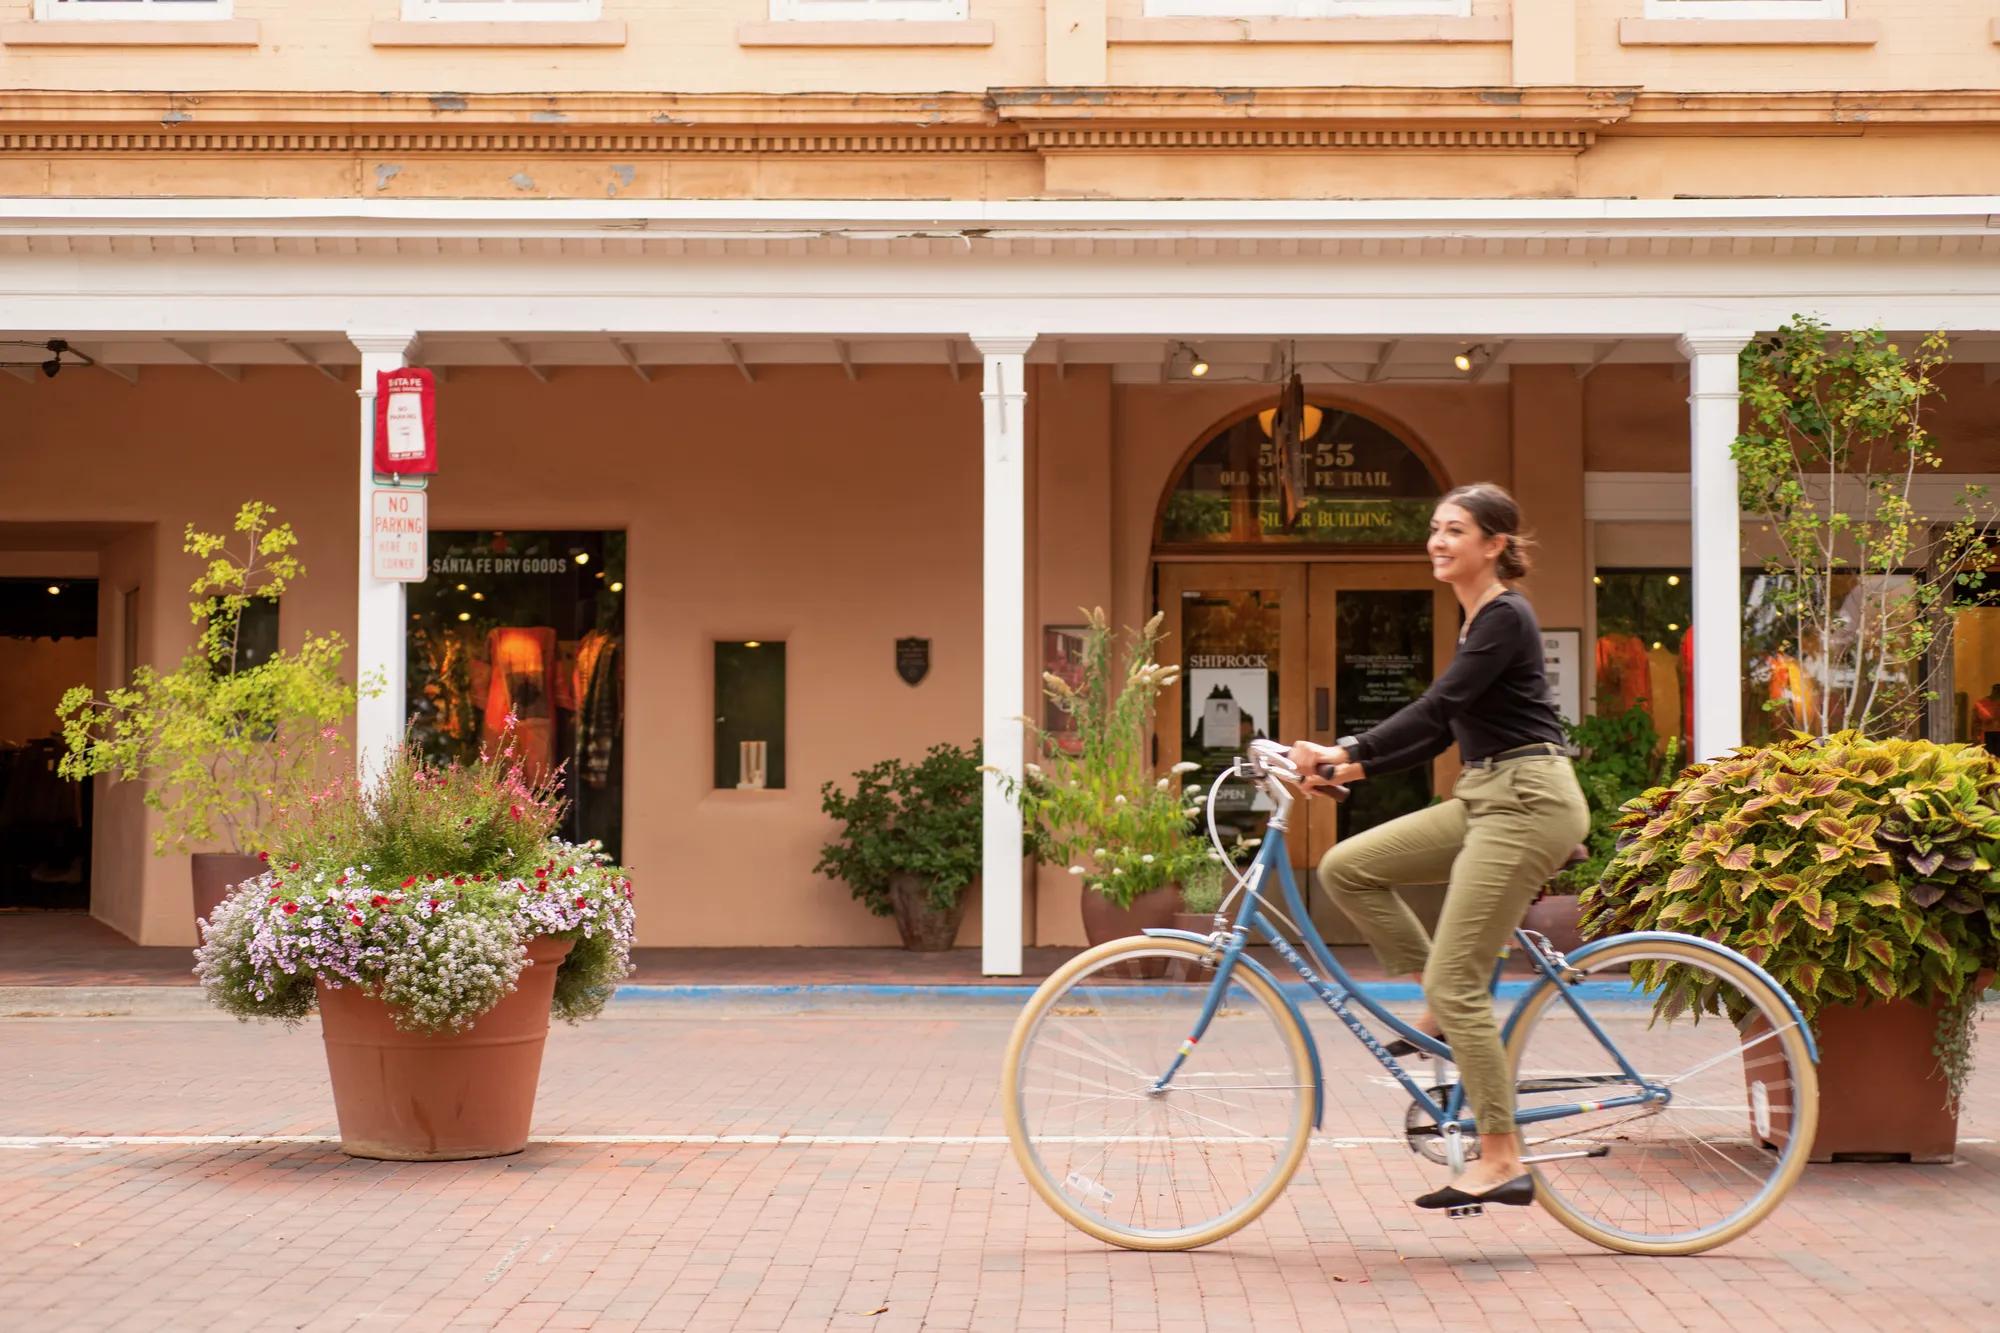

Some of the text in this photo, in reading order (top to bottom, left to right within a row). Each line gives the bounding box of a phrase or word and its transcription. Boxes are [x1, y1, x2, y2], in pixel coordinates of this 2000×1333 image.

[1220, 471, 1250, 486] OLD
[1314, 471, 1335, 486] FE
[1343, 471, 1391, 486] TRAIL
[388, 496, 409, 512] NO
[375, 517, 423, 534] PARKING
[1259, 511, 1312, 528] SILR
[1317, 510, 1392, 527] BUILDING
[432, 558, 567, 573] SANTA FE DRY GOODS
[1190, 654, 1268, 668] SHIPROCK
[1216, 789, 1246, 800] OPEN
